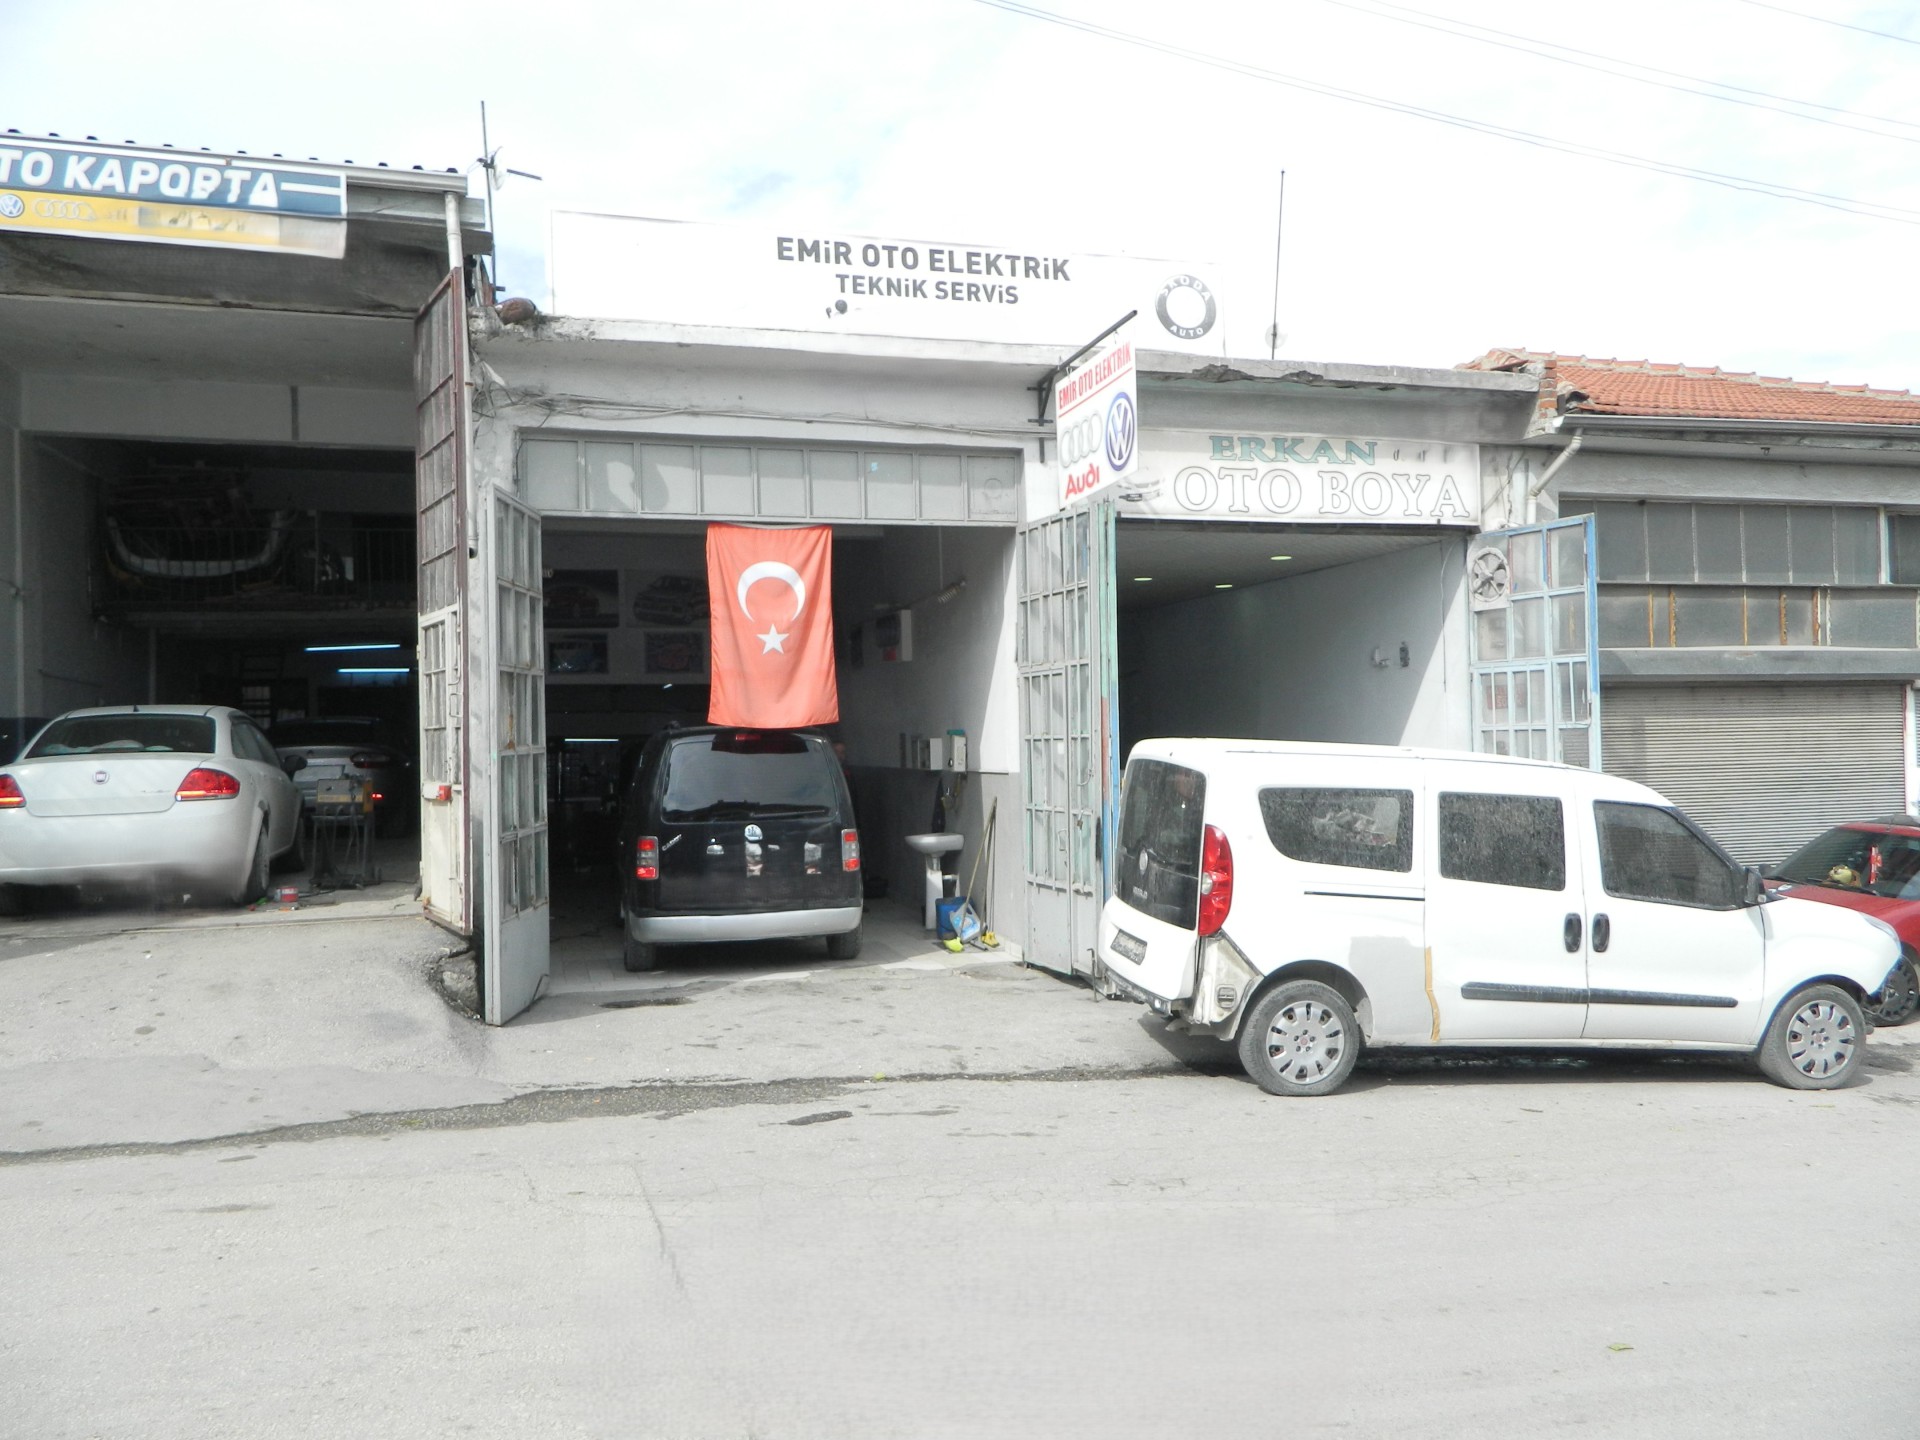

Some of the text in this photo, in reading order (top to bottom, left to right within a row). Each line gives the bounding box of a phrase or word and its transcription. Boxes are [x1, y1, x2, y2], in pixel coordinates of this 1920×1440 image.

[862, 244, 919, 270] OTO
[1170, 325, 1204, 337] AUTO
[1078, 368, 1094, 397] OTO
[1209, 435, 1377, 465] ERKAN
[1174, 466, 1470, 517] OTO BOYA
